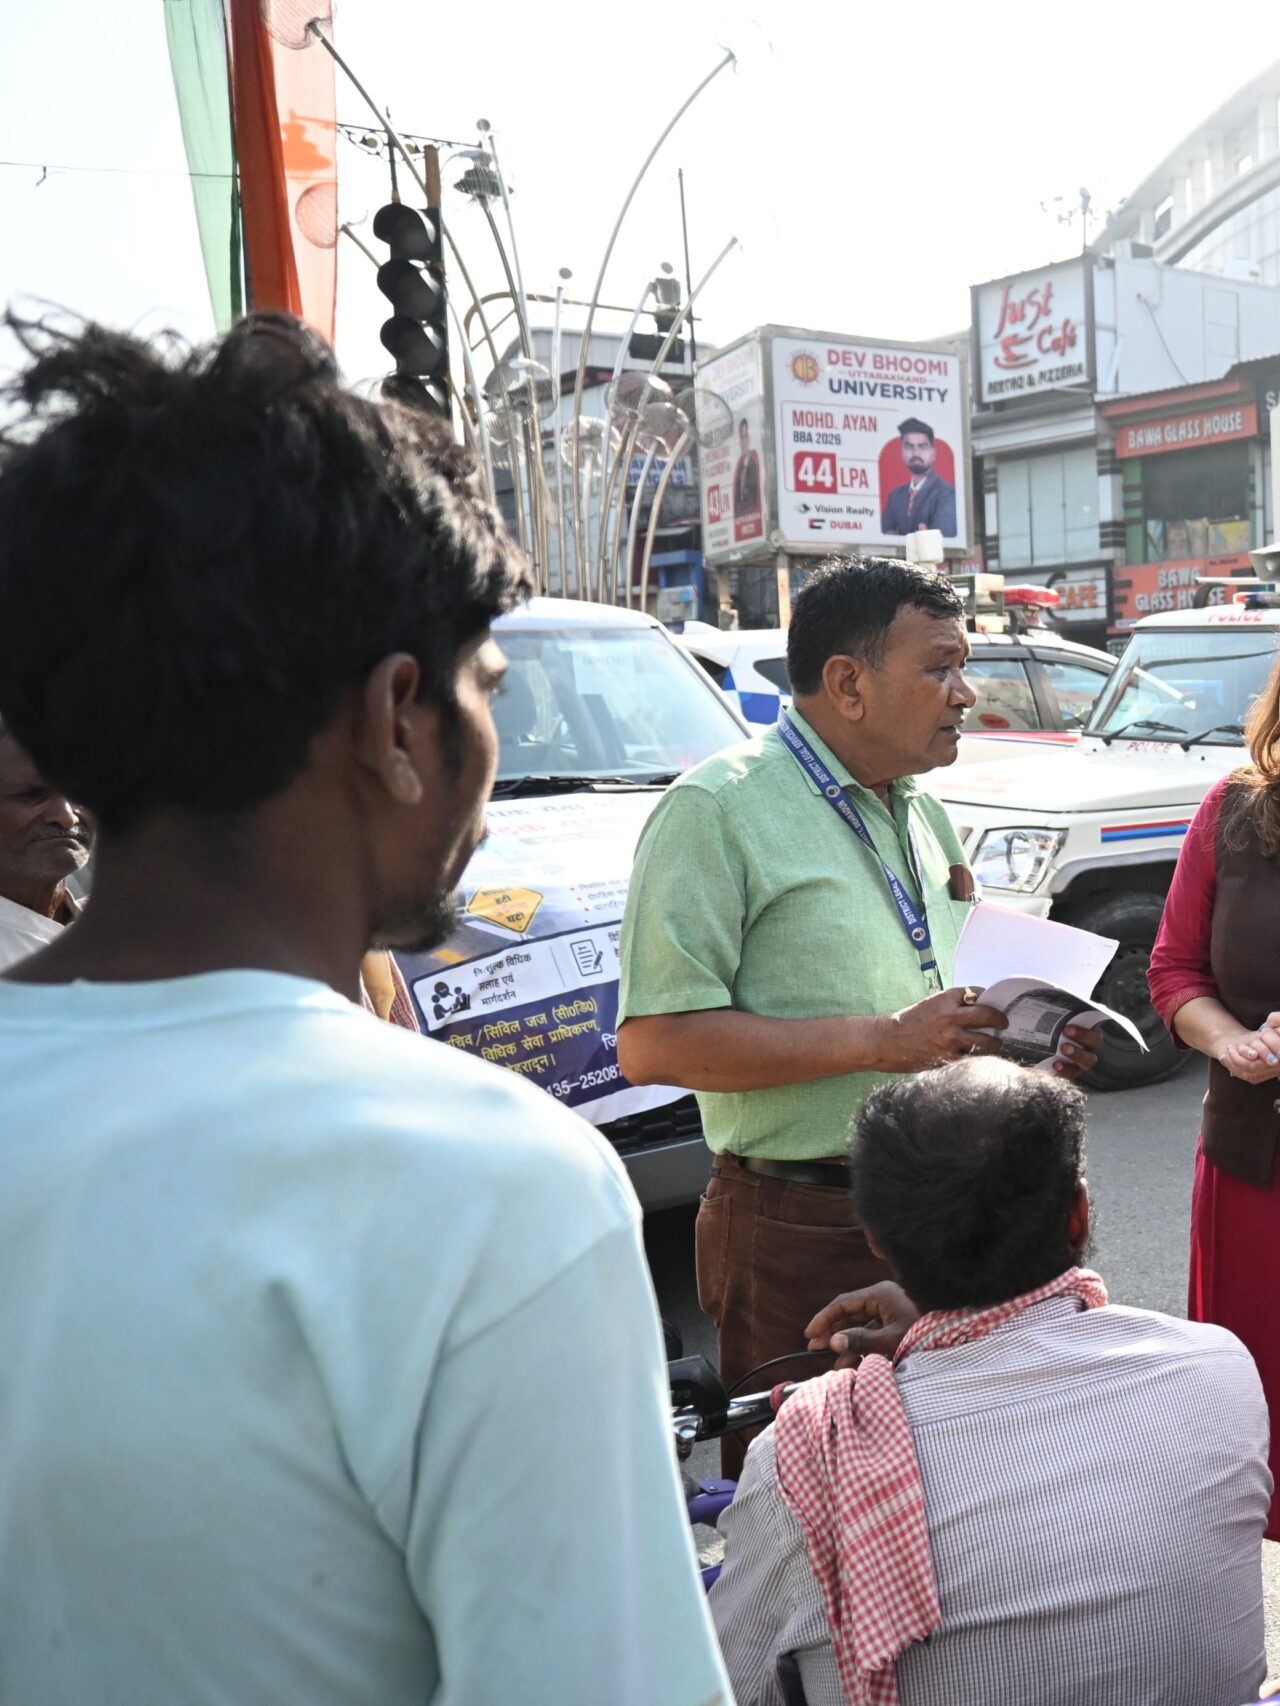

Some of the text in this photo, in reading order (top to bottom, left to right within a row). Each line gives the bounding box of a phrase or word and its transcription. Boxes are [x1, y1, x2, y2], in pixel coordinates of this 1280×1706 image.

[827, 349, 949, 377] DEV BHOOMI
[828, 377, 949, 403] UNIVERSITY
[848, 370, 927, 385] UTTARAKHAND
[792, 410, 878, 432] MOHD. AYAN
[1128, 411, 1243, 450] BAWA GLASS HOUSE
[793, 430, 842, 445] BBA 2026
[797, 457, 869, 489] 44 LPA
[814, 503, 874, 517] Vision Realty
[830, 520, 863, 531] DUBAI
[1135, 586, 1226, 612] GLASS HOSE
[798, 745, 814, 764] LEGAL
[1127, 741, 1173, 754] POLICE
[809, 759, 830, 784] DISTRICT
[837, 799, 862, 830] DEHRADUN
[897, 899, 917, 925] DISTRICT
[506, 952, 532, 967] विधिक
[481, 989, 517, 1006] मार्गदर्शन
[484, 1018, 521, 1041] सिविल
[524, 1012, 548, 1028] जज
[481, 1043, 517, 1062] विधिक
[521, 1034, 544, 1051] सेवा
